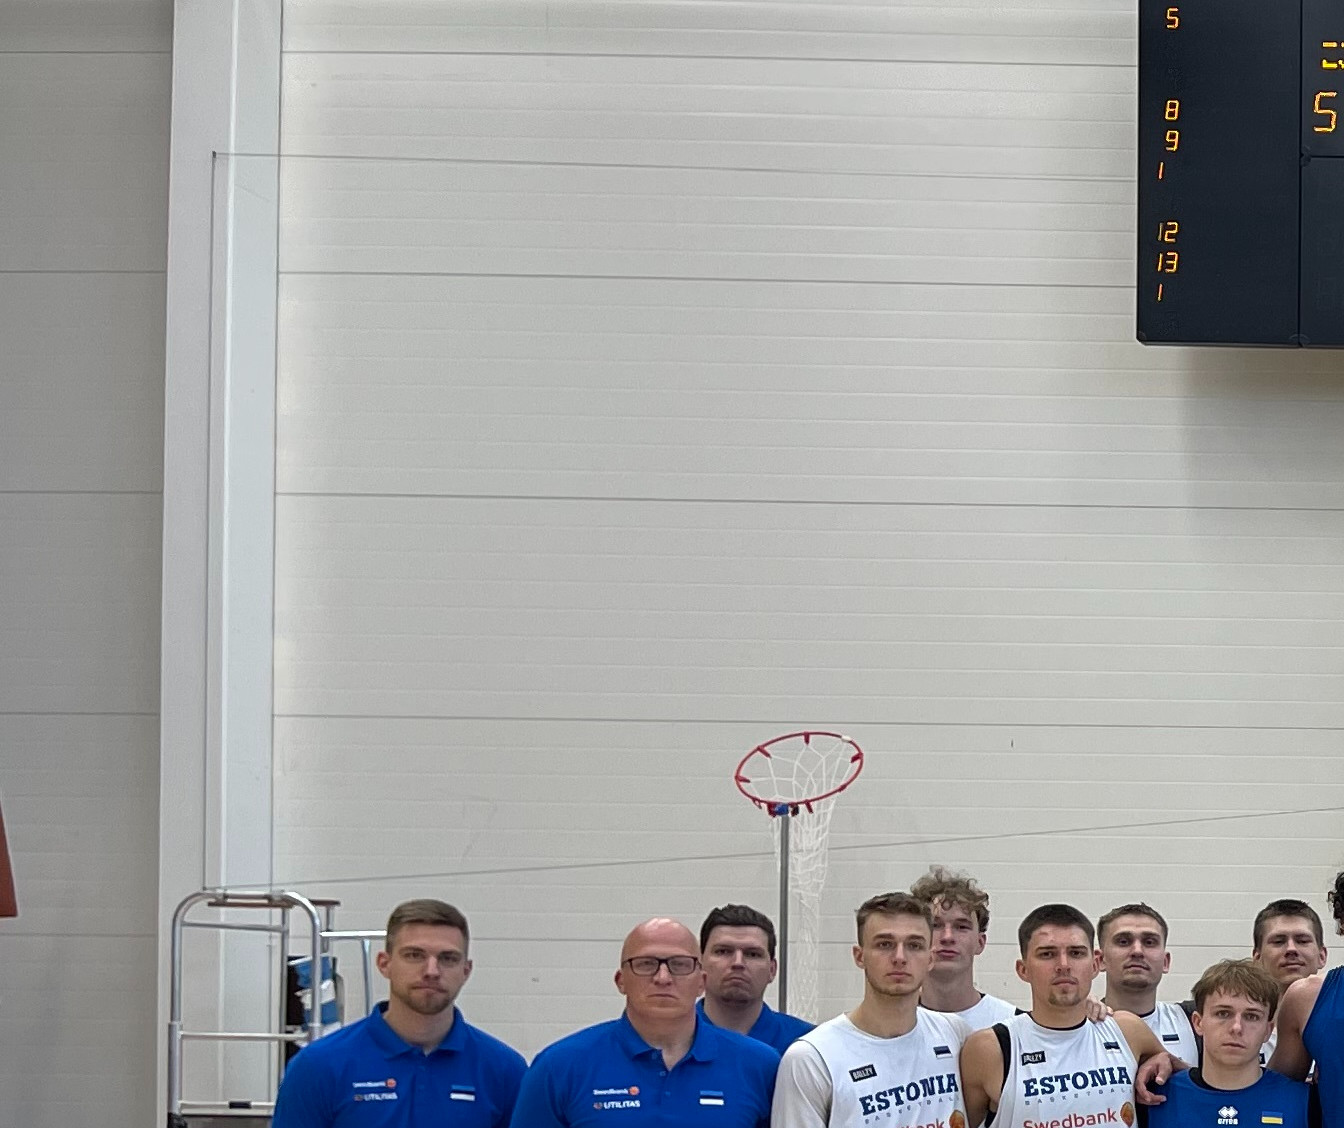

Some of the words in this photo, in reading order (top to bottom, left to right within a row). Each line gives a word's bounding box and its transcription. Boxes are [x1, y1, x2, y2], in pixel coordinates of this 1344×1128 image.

[1166, 8, 1179, 28] 5
[1165, 100, 1179, 120] 8
[1313, 91, 1338, 132] 5
[1165, 131, 1179, 151] 9
[1158, 222, 1178, 242] 12
[1158, 252, 1178, 273] 13
[1023, 1066, 1132, 1098] ESTONIA
[604, 1100, 641, 1109] UTILITAS
[859, 1073, 959, 1116] ESTONIA
